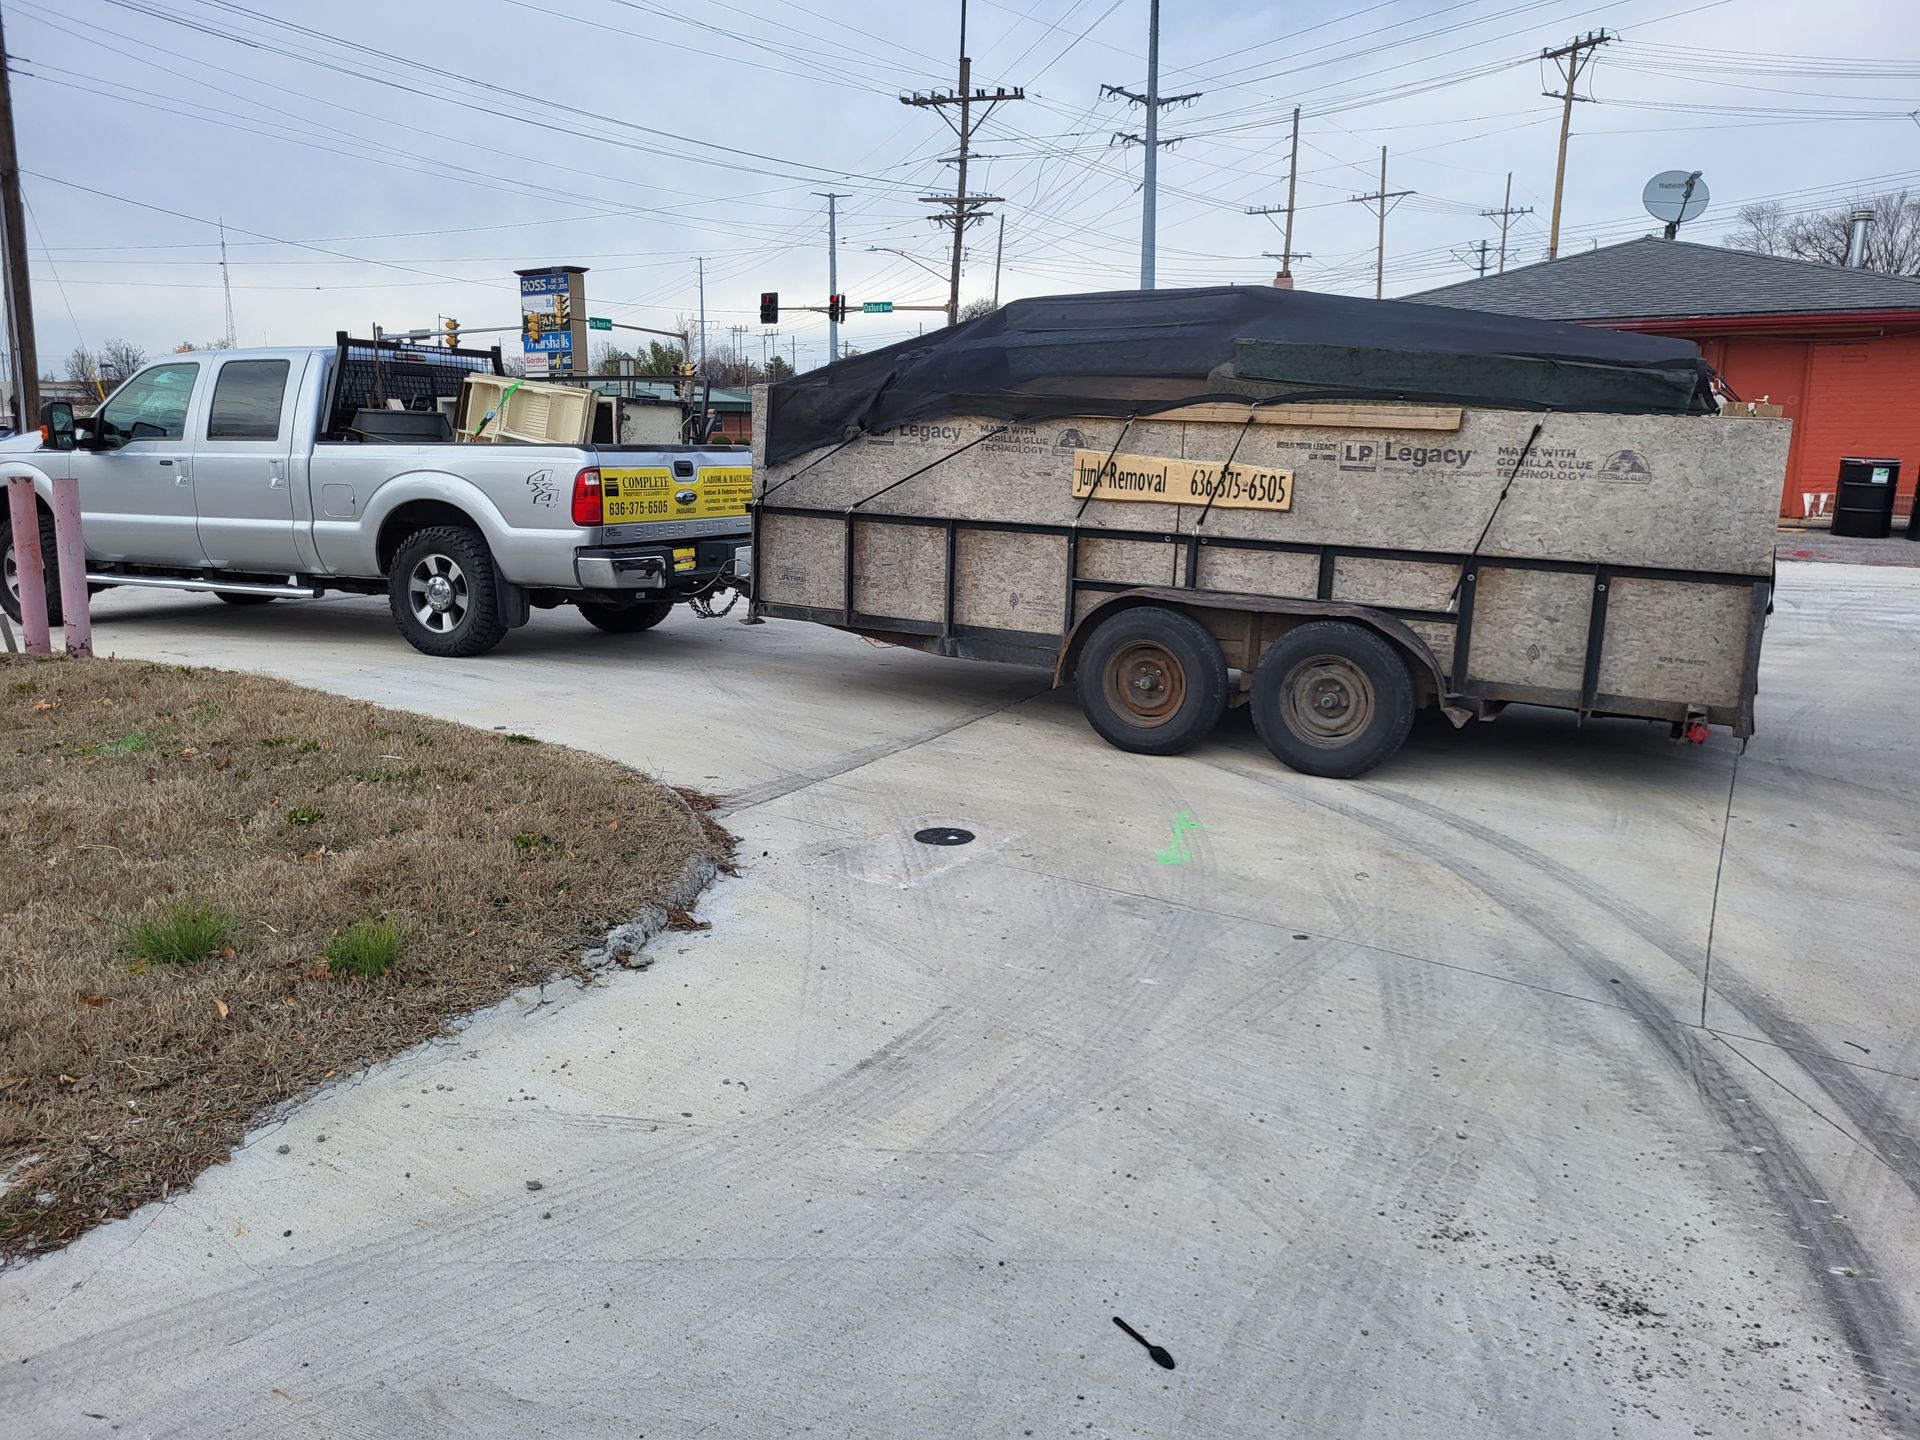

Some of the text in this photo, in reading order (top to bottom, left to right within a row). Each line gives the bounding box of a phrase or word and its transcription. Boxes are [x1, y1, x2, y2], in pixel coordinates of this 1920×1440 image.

[522, 279, 546, 292] ROSS
[400, 344, 453, 354] BACKRACK
[526, 356, 547, 364] Gordon
[900, 424, 962, 444] Legacy
[1011, 426, 1036, 435] WITH
[1023, 437, 1049, 445] GLUE
[1313, 442, 1337, 450] LEGACY
[980, 443, 1045, 454] TECHNOLOGY
[1345, 445, 1373, 461] LP
[1541, 447, 1576, 458] WITH
[1384, 441, 1472, 469] Legacy
[1558, 460, 1593, 470] GLUE
[702, 475, 722, 484] LABOR
[723, 475, 728, 483] &
[1076, 458, 1168, 493] Junk Removal
[622, 476, 670, 489] COMPLETE
[717, 488, 721, 496] &
[609, 500, 668, 516] 636-375-6505
[634, 523, 686, 539] SUPER
[695, 520, 730, 534] DUTY
